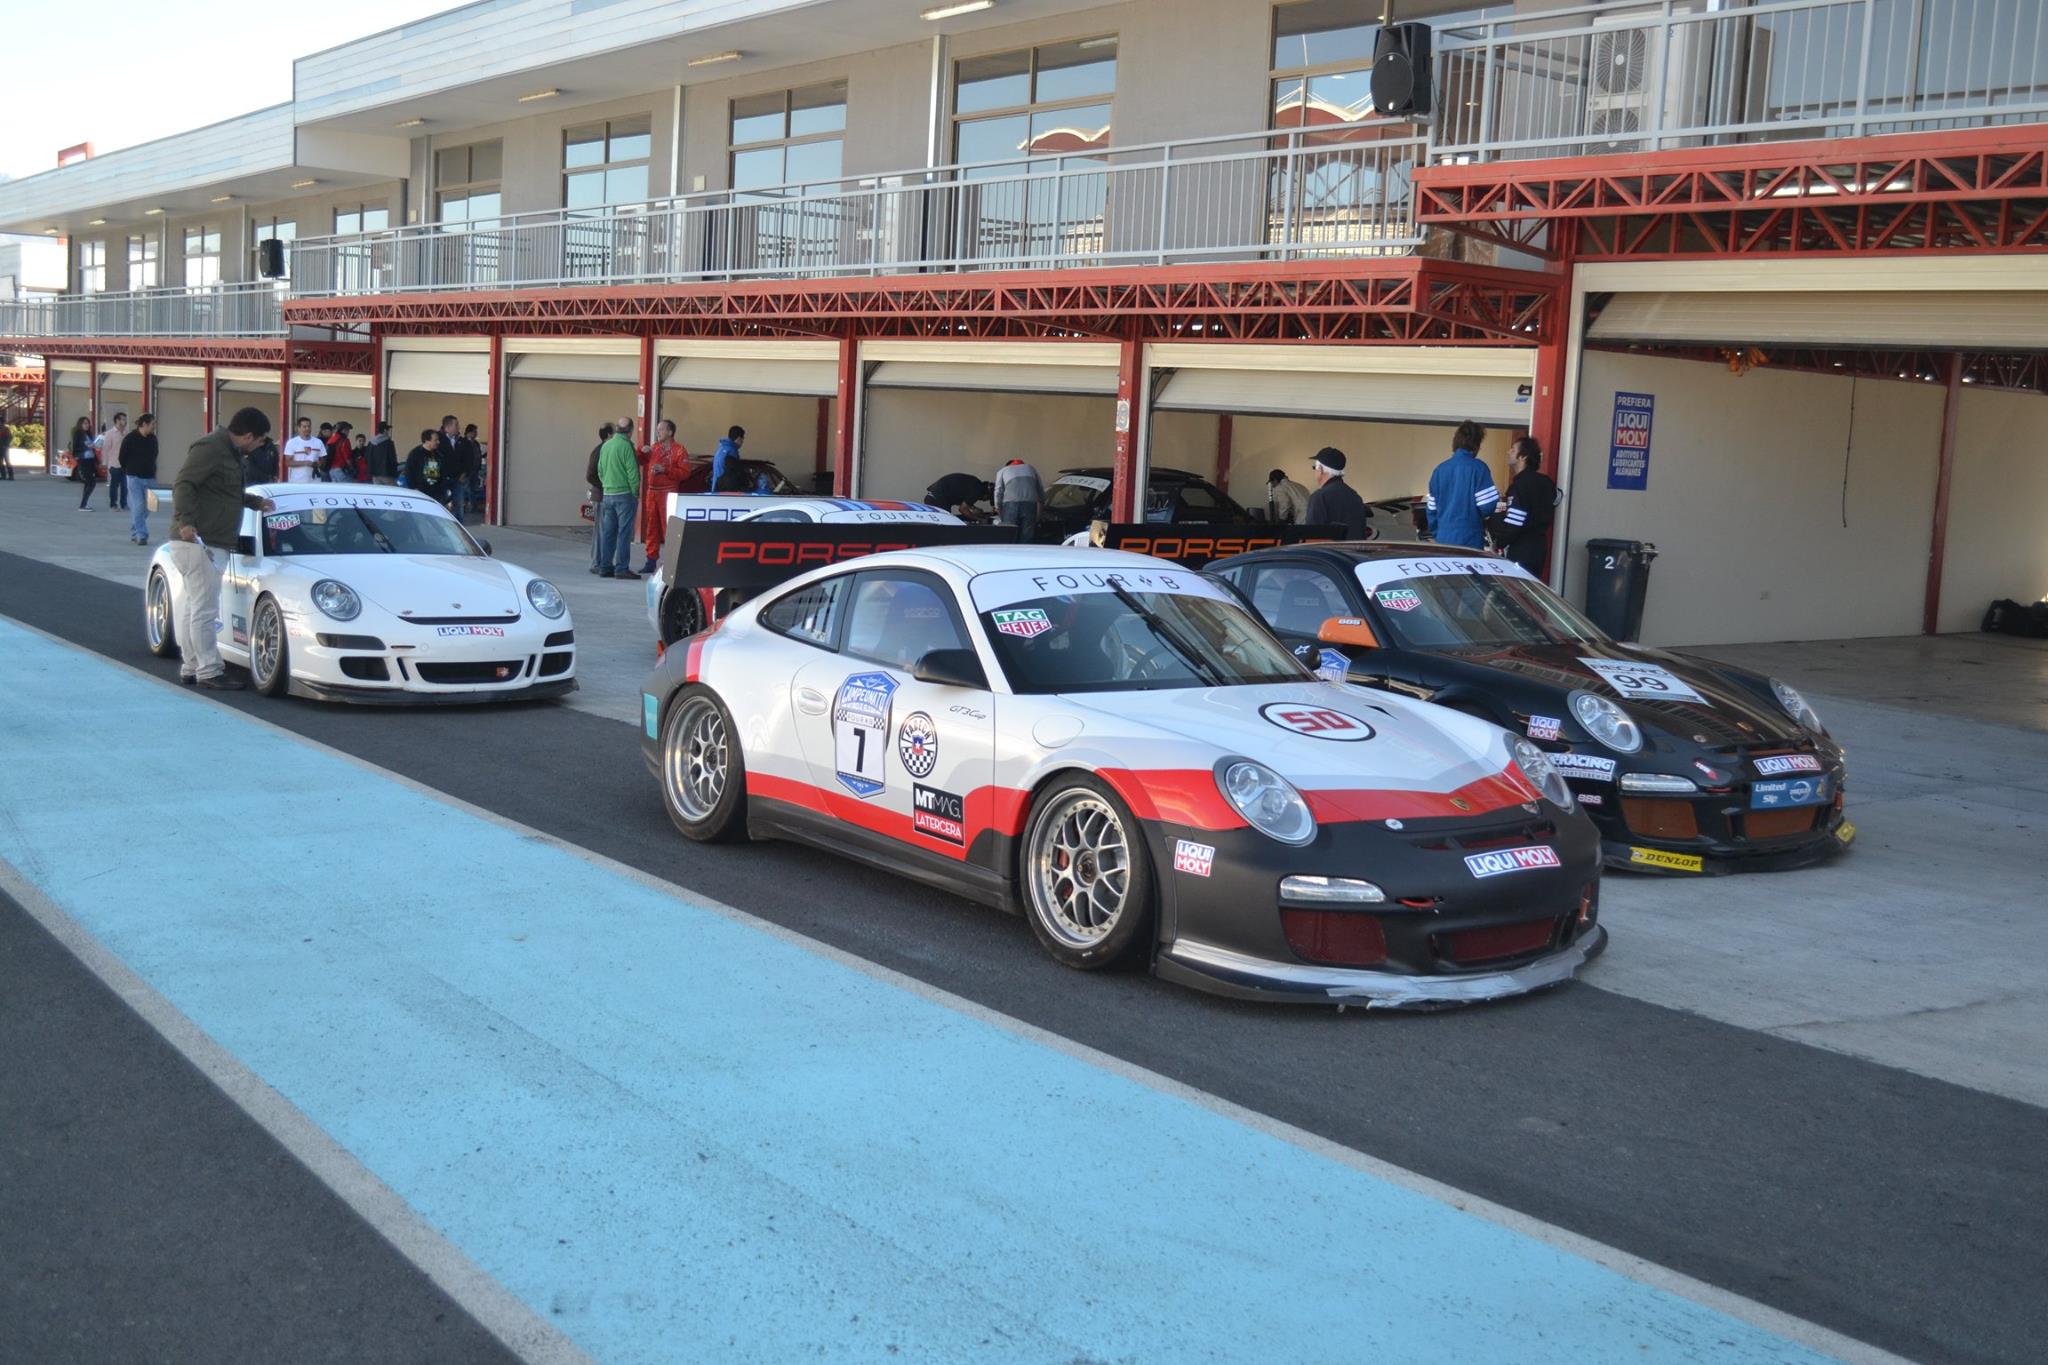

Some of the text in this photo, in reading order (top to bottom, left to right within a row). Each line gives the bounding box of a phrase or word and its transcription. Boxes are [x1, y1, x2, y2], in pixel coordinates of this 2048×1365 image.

[1617, 396, 1651, 408] PREFIERA
[1618, 412, 1649, 429] LIQUI
[1616, 429, 1648, 446] MOLY
[308, 496, 414, 511] FOUR B
[268, 514, 299, 523] TAG
[856, 511, 941, 523] FOUR B
[1397, 561, 1504, 576] FOUR B
[1604, 555, 1615, 570] 2
[1031, 572, 1181, 594] FOUR B
[1380, 590, 1416, 599] TAG
[1381, 599, 1422, 611] HEUER
[996, 611, 1045, 622] TAG
[439, 626, 503, 637] LIQUI MOLY
[999, 620, 1050, 637] HEUER
[1613, 674, 1669, 691] 99
[841, 685, 888, 712] CAMPEONATO
[1278, 710, 1358, 732] 50
[1531, 717, 1559, 729] LIQUI
[905, 719, 931, 740] FADECH
[1530, 727, 1557, 740] MOLY
[853, 727, 866, 773] 7
[1757, 756, 1819, 773] LIQUI MOLY
[1755, 782, 1786, 792] Limited
[1762, 794, 1778, 804] Slip
[1178, 843, 1212, 860] LIQUI
[1177, 856, 1209, 875] MOLY
[1470, 848, 1558, 874] LIQUI MOLY
[1645, 852, 1699, 868] DUNLOP
